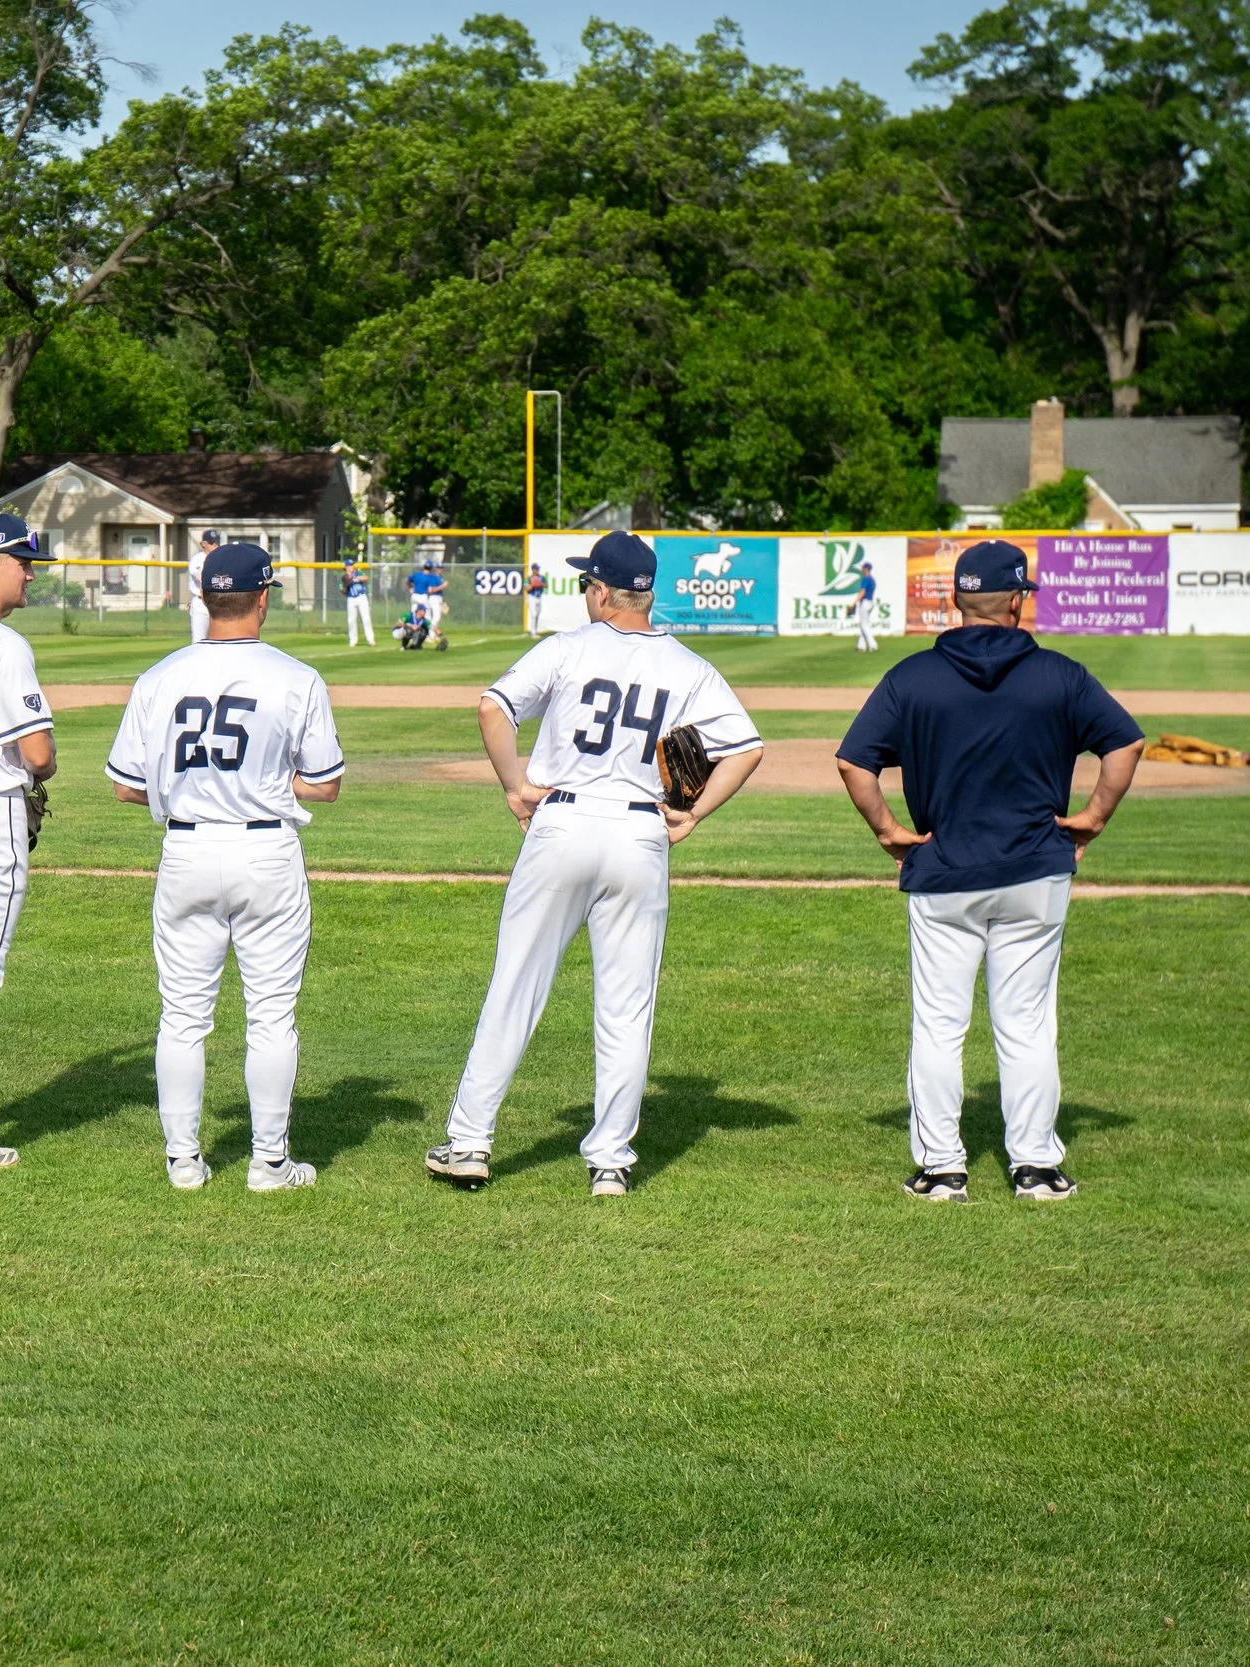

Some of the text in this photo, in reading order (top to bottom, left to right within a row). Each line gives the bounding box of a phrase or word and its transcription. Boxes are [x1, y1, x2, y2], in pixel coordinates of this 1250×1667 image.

[1054, 540, 1153, 552] Hit A Home Run
[1074, 556, 1132, 570] By Joining
[475, 570, 523, 595] 320
[676, 579, 755, 595] SCOOPY
[1040, 572, 1165, 588] Muskegon Federal
[1177, 571, 1250, 587] COR
[694, 594, 735, 610] DOO
[1057, 591, 1148, 606] Credit Union
[1060, 612, 1146, 627] 231-722-7285
[573, 678, 669, 765] 34
[174, 695, 257, 773] 25
